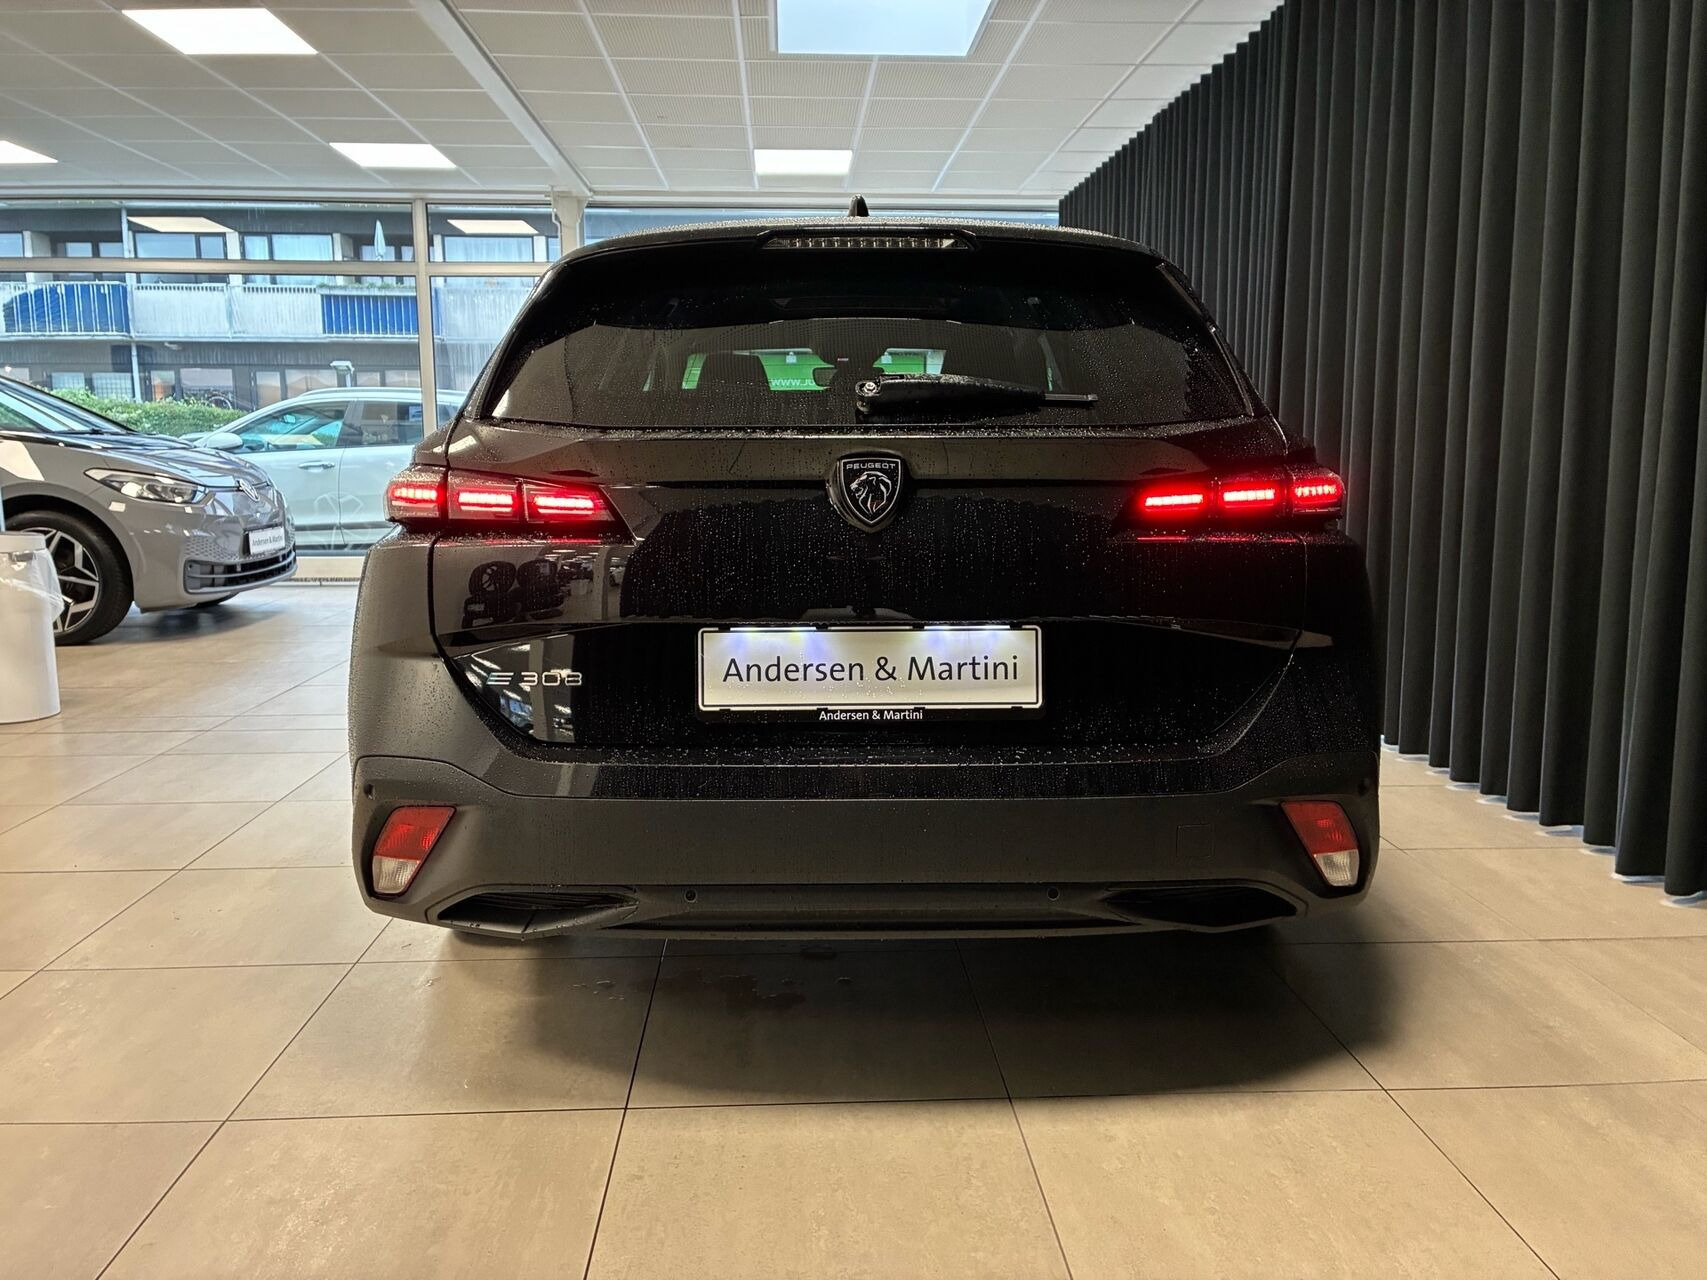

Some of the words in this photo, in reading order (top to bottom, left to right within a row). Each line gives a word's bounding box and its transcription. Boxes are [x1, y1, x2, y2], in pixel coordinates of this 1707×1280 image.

[846, 462, 896, 470] PEUGEOT
[722, 655, 864, 682] Andersen
[875, 656, 897, 681] &
[907, 655, 1018, 681] Martini
[519, 671, 582, 686] 308
[819, 710, 870, 720] Andersen
[871, 709, 880, 720] &
[883, 709, 923, 720] Martini
